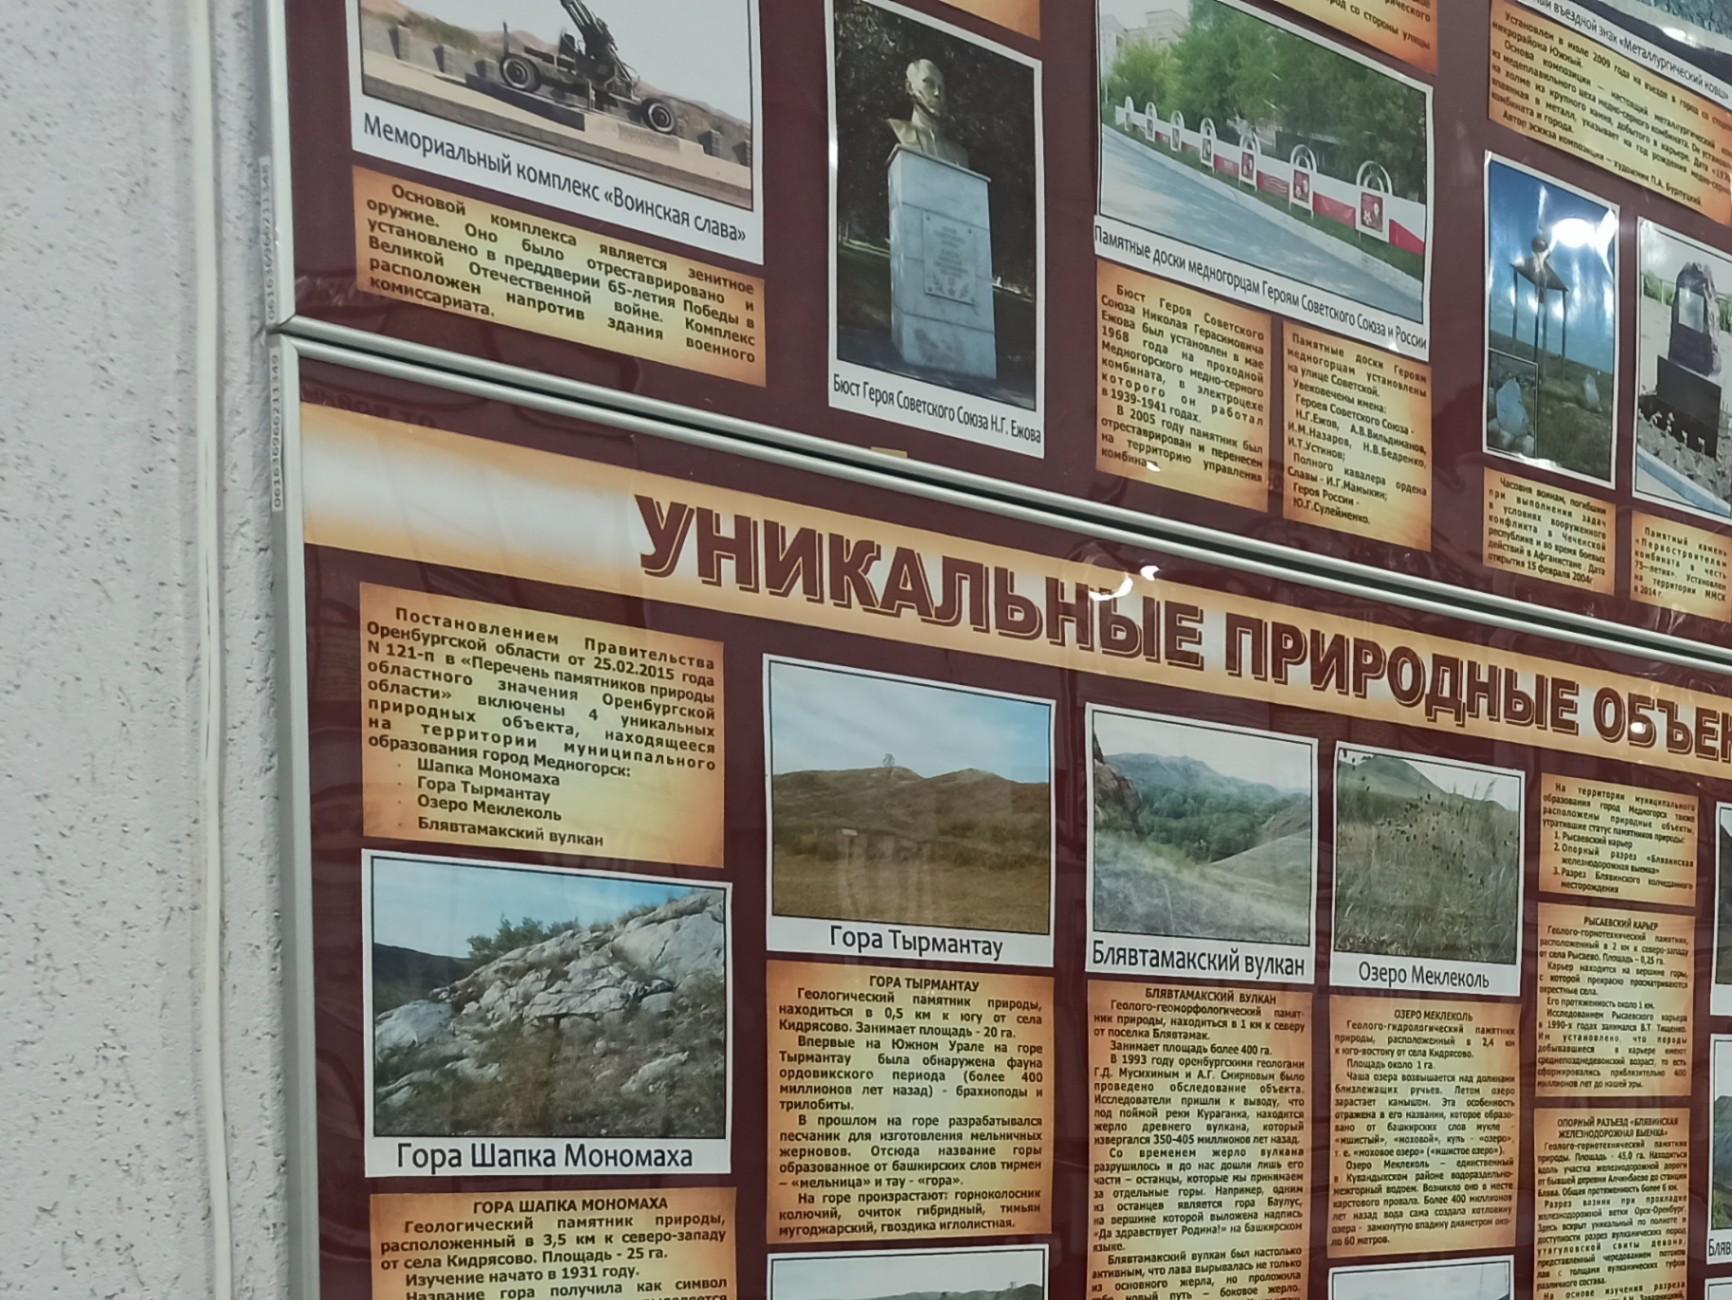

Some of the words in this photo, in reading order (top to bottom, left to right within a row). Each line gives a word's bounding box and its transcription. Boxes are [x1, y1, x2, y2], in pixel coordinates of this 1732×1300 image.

[364, 111, 511, 176] Мемориальный
[516, 162, 600, 202] комплекс
[603, 186, 690, 227] «Воинская
[693, 215, 746, 241] слава»
[366, 199, 439, 228] оружие.
[464, 222, 498, 243] Оно
[521, 237, 564, 261] было
[586, 258, 725, 304] отреставрировано
[745, 301, 754, 312] и
[391, 183, 466, 216] Основой
[490, 213, 577, 246] комплекса
[599, 243, 667, 271] является
[687, 267, 754, 294] зенитное
[367, 218, 478, 256] установлено
[486, 249, 496, 261] в
[504, 254, 600, 288] преддверии
[607, 279, 675, 308] 65-летия
[683, 298, 739, 325] Победы
[746, 318, 754, 328] в
[368, 235, 444, 267] Великой
[468, 260, 591, 304] Отечественной
[613, 300, 663, 322] войне.
[684, 316, 755, 346] Комплекс
[1094, 222, 1151, 258] Памятные
[1152, 248, 1185, 270] доски
[1187, 259, 1260, 294] медногорцам
[1261, 279, 1299, 307] Героям
[1300, 293, 1355, 326] Советского
[1356, 312, 1386, 336] Союза
[1387, 326, 1393, 337] и
[1395, 324, 1426, 350] России
[369, 257, 481, 295] расположен
[506, 291, 585, 320] напротив
[607, 316, 663, 340] здания
[686, 336, 755, 363] военного
[370, 276, 494, 317] комиссариата.
[833, 372, 861, 396] Бюст
[862, 380, 894, 407] Героя
[896, 389, 955, 422] Советского
[956, 405, 988, 430] Союза
[990, 413, 1008, 435] Н.Г.
[1010, 419, 1041, 443] Ежова
[633, 493, 1205, 672] УНИКАЛЬНЫЕ
[1224, 610, 1580, 737] ПРИРОДНЫЕ
[366, 620, 486, 652] Оренбургской
[495, 642, 560, 663] области
[567, 654, 585, 666] от
[593, 655, 674, 680] 25.02.2015
[682, 672, 714, 687] года
[395, 606, 558, 645] Постановлением
[584, 636, 714, 669] Правительства
[367, 639, 379, 654] N
[386, 642, 434, 662] 121-п
[445, 654, 455, 665] в
[460, 655, 549, 679] «Перечень
[554, 670, 645, 693] памятников
[650, 684, 714, 704] природы
[367, 659, 473, 686] областного
[497, 679, 578, 701] значения
[601, 692, 714, 720] Оренбургской
[367, 678, 452, 700] области»
[477, 695, 565, 717] включены
[588, 708, 598, 721] 4
[620, 714, 714, 737] уникальных
[417, 756, 473, 776] Шапка
[478, 764, 560, 786] Мономаха
[417, 775, 456, 794] Гора
[460, 779, 550, 805] Тырмантау
[417, 793, 468, 813] Озеро
[472, 799, 562, 821] Меклеколь
[417, 815, 544, 840] Блявтамакский
[548, 831, 603, 846] вулкан
[1583, 915, 1632, 928] РЫСАЕВСКИЙ
[1632, 920, 1658, 931] КАРЬЕР
[830, 924, 883, 953] Гора
[887, 928, 1003, 962] Тырмантау
[1092, 939, 1239, 973] Блявтамакский
[1244, 955, 1304, 980] вулкан
[869, 975, 901, 988] ГОРА
[904, 977, 979, 992] ТЫРМАНТАУ
[1358, 960, 1407, 985] Озеро
[1411, 964, 1489, 989] Меклеколь
[1145, 987, 1234, 1002] БЛЯВТАМАКСКИЙ
[1239, 992, 1276, 1004] ВУЛКАН
[1393, 1008, 1422, 1020] ОЗЕРО
[1423, 1009, 1473, 1022] МЕКЛЕКОЛЬ
[1109, 1039, 1160, 1052] Занимает
[1162, 1043, 1208, 1055] площадь
[1209, 1042, 1239, 1055] более
[1240, 1044, 1258, 1055] 400
[1259, 1047, 1272, 1055] га.
[397, 1142, 462, 1175] Гора
[471, 1142, 556, 1168] Шапка
[564, 1142, 692, 1168] Мономаха
[404, 1215, 533, 1233] Геологический
[557, 1216, 633, 1229] памятник
[655, 1214, 725, 1228] природы,
[473, 1200, 514, 1214] ГОРА
[518, 1198, 577, 1213] ШАПКА
[581, 1196, 668, 1211] МОНОМАХА
[380, 1233, 515, 1256] расположенный
[524, 1236, 534, 1247] в
[543, 1232, 566, 1249] 3,5
[575, 1234, 595, 1245] км
[604, 1233, 613, 1244] к
[621, 1230, 726, 1245] северо-западу
[405, 1273, 484, 1289] Изучение
[488, 1270, 543, 1283] начато
[547, 1270, 556, 1280] в
[561, 1265, 597, 1279] 1931
[602, 1266, 639, 1279] году.
